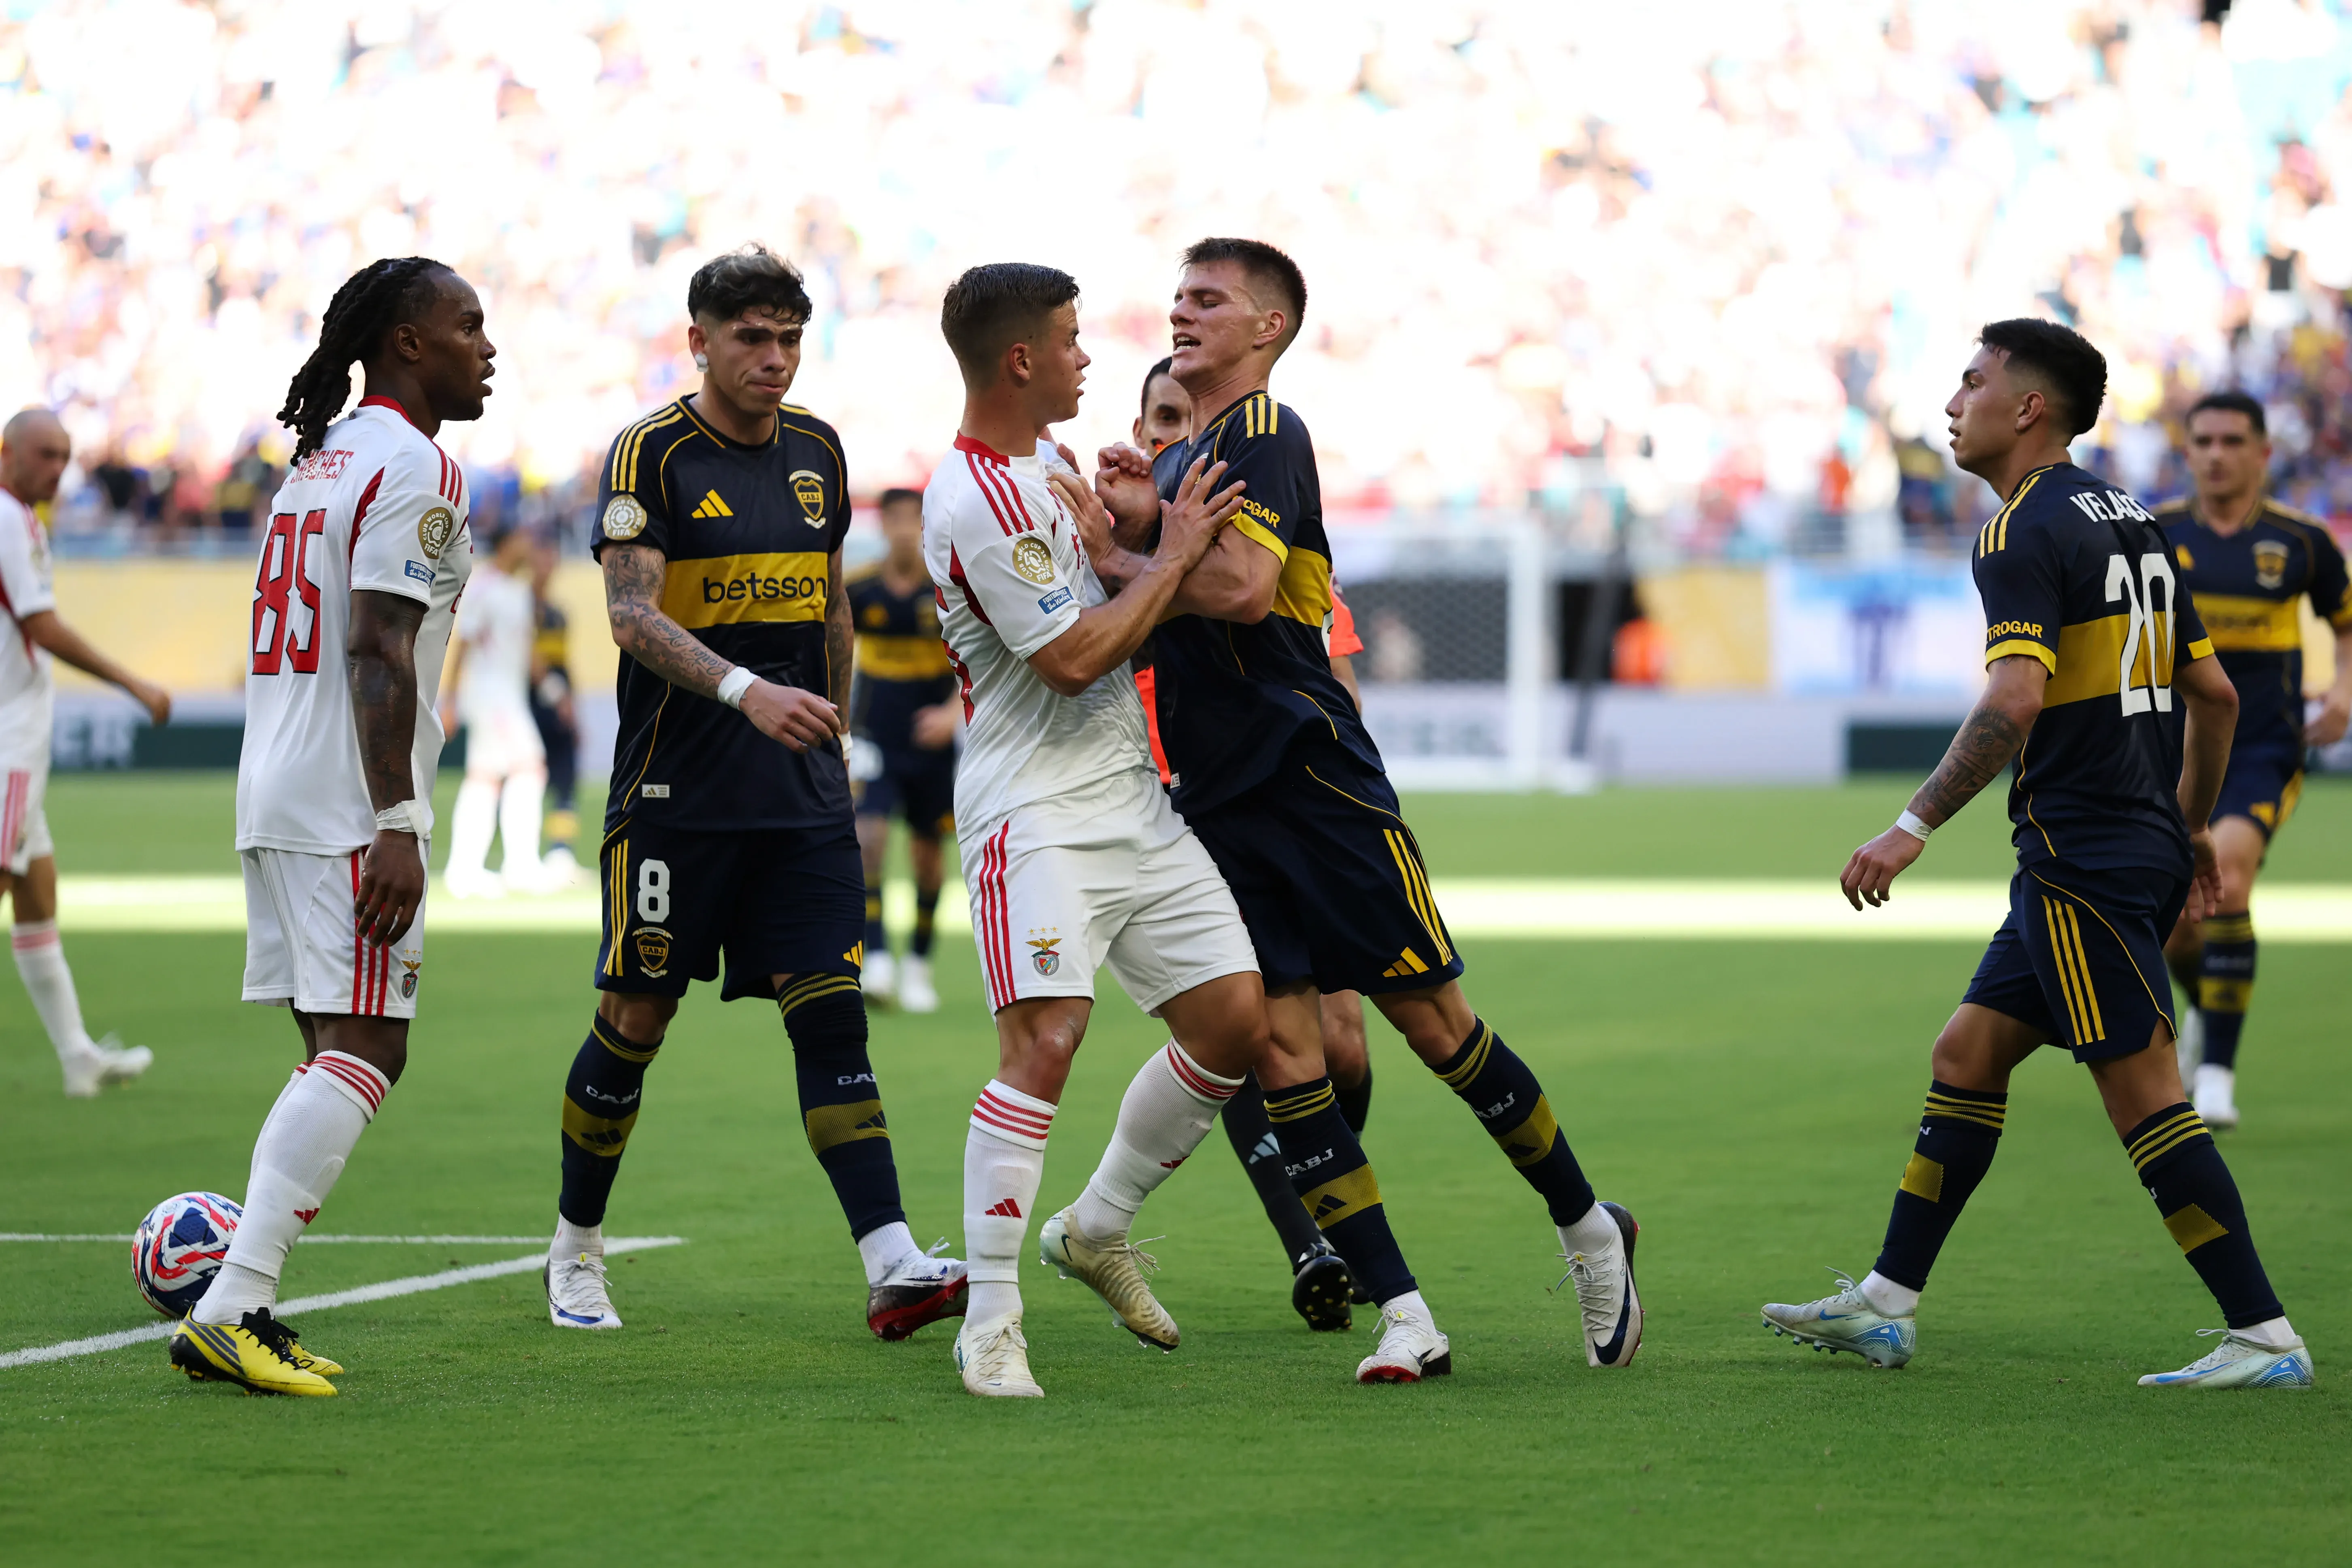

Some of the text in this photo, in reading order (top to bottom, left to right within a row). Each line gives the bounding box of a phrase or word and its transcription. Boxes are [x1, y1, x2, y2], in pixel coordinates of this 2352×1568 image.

[427, 512, 445, 522] WORLD
[1232, 495, 1280, 528] OGAR
[424, 544, 438, 556] FIFA
[1017, 543, 1029, 561] WORLD
[1019, 563, 1033, 577] CLUB
[1036, 572, 1052, 582] FIFA
[252, 508, 327, 675] 85
[703, 572, 827, 603] betsson
[1047, 602, 1056, 610] the
[1986, 620, 2042, 643] TROGAR
[2105, 553, 2175, 716] 20
[637, 858, 670, 923] 8
[1468, 1092, 1515, 1118] ABJ
[1285, 1148, 1334, 1176] CABJ
